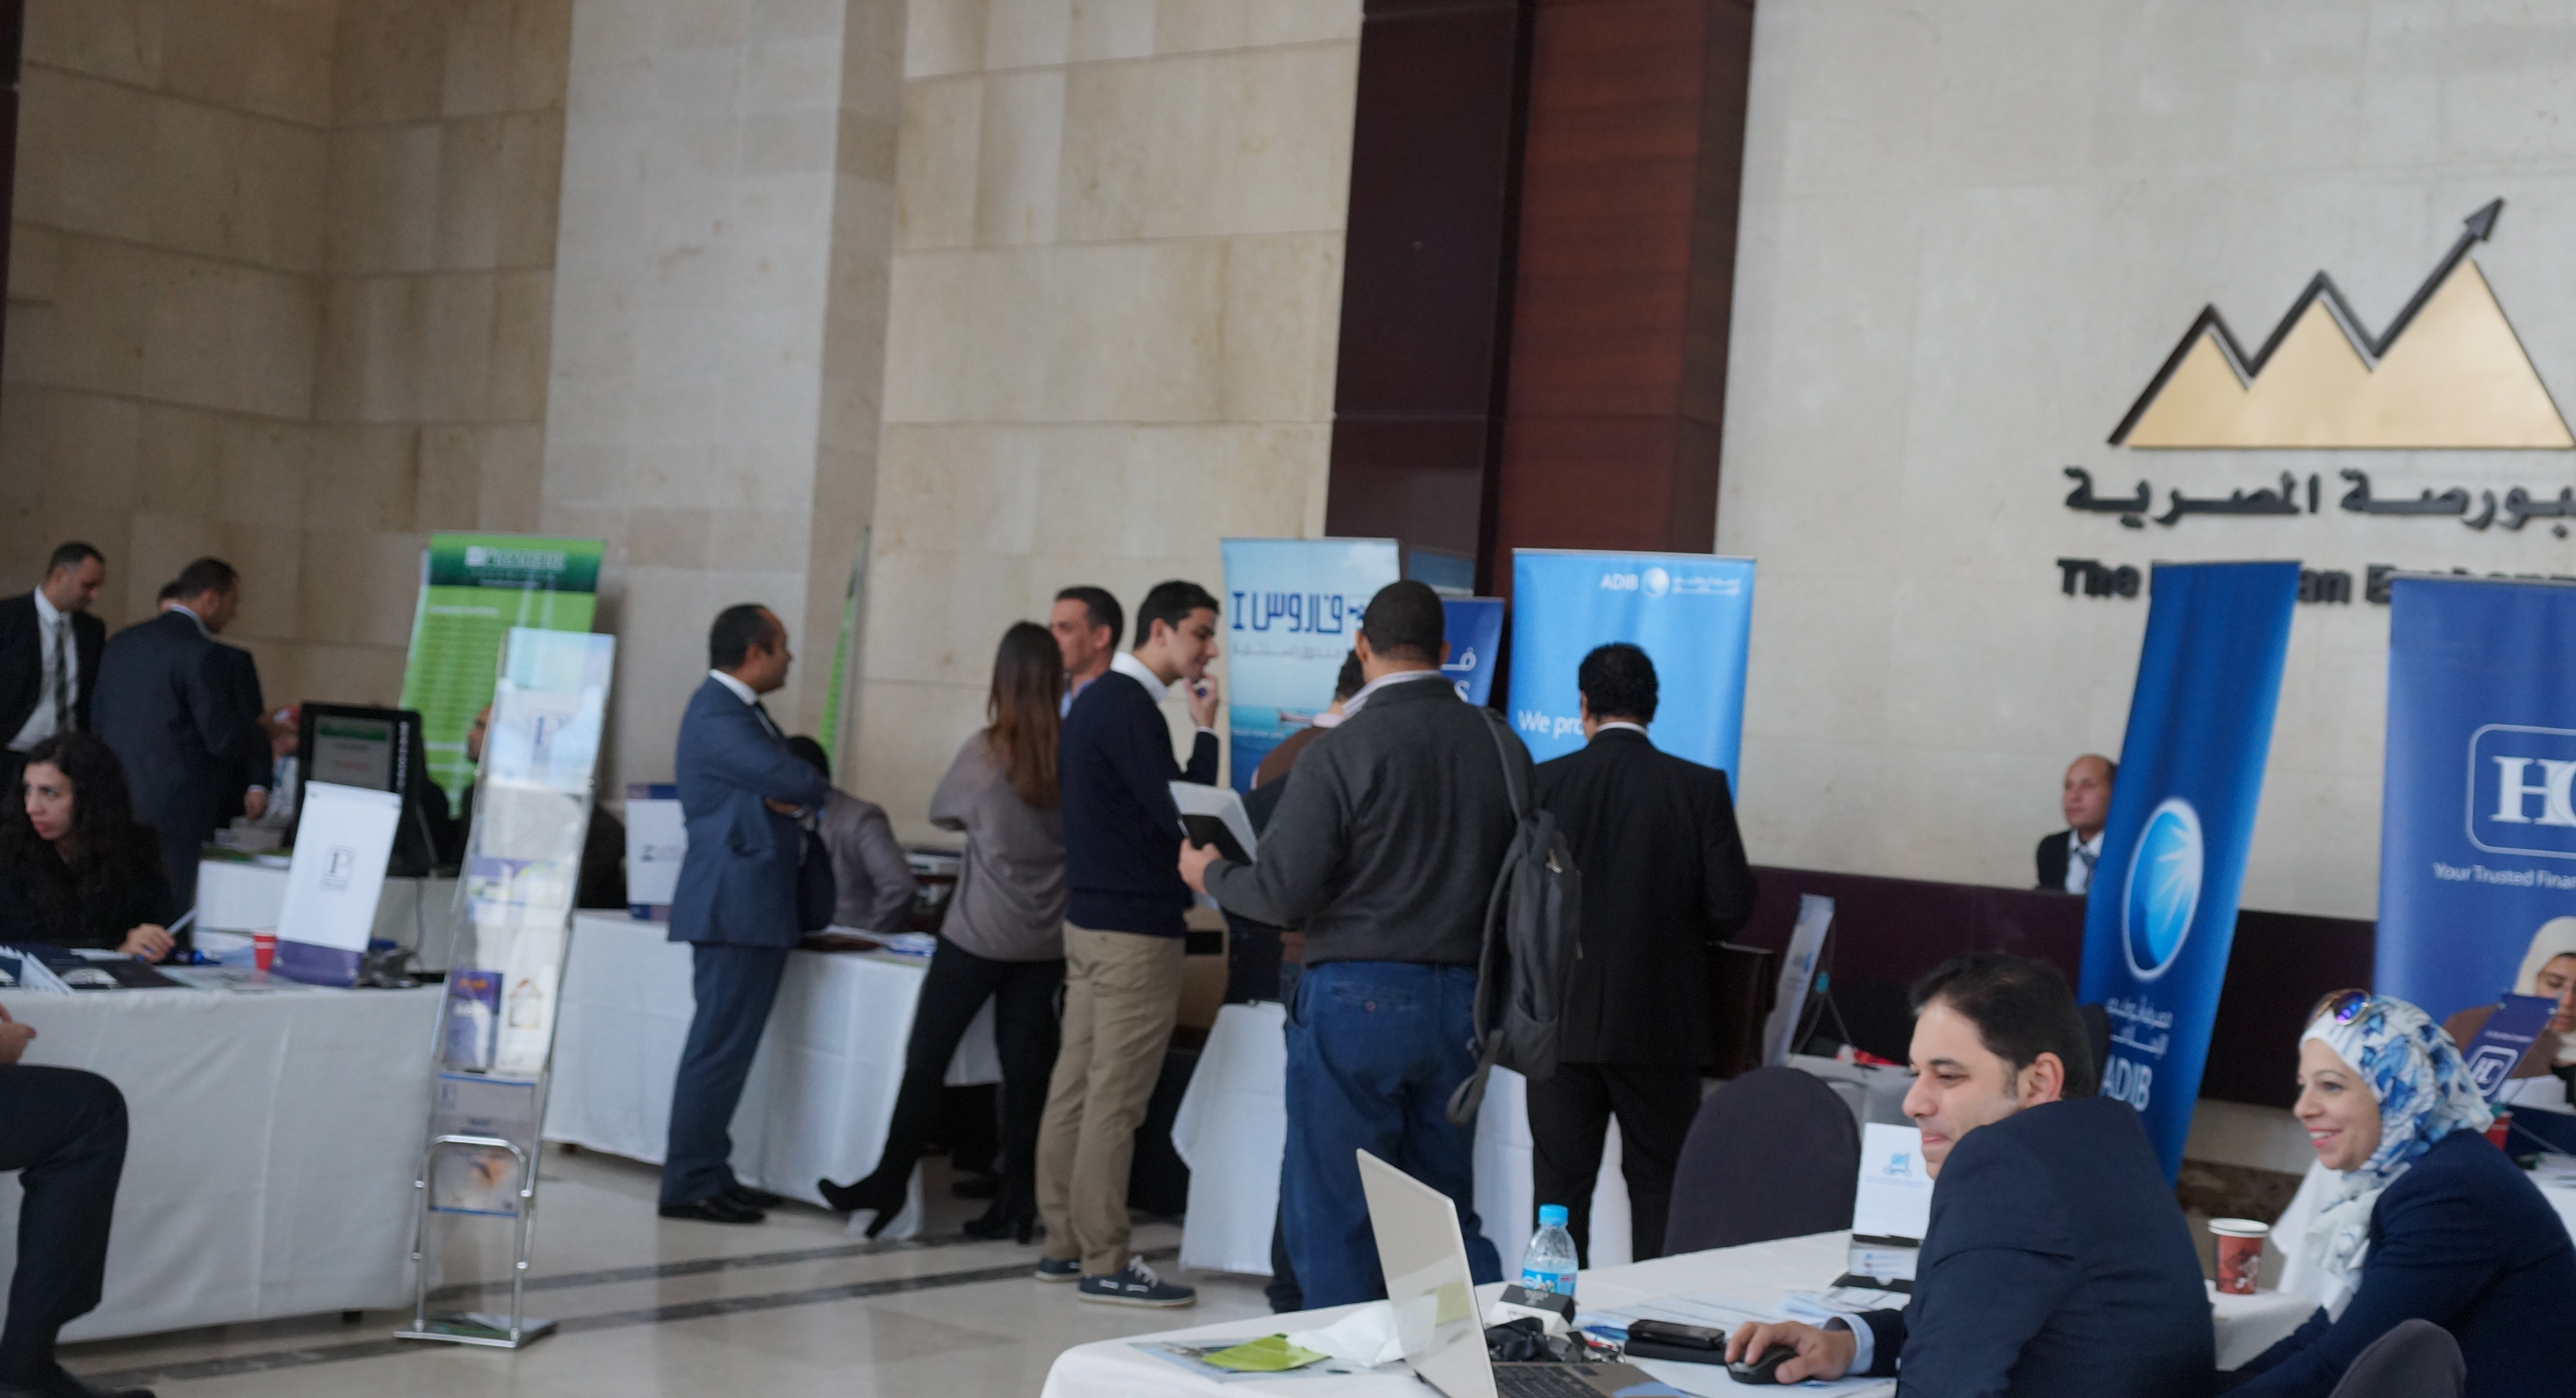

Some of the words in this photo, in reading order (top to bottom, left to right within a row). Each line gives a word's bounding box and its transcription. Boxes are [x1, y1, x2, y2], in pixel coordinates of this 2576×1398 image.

[2064, 466, 2319, 529] المصرية
[1601, 573, 1639, 591] ADIB
[2058, 558, 2142, 599] The
[1252, 592, 1343, 634] فاروس
[1517, 709, 1551, 733] We
[2432, 862, 2471, 882] Your
[2472, 864, 2535, 887] Trusted
[2099, 1054, 2153, 1111] ADIB
